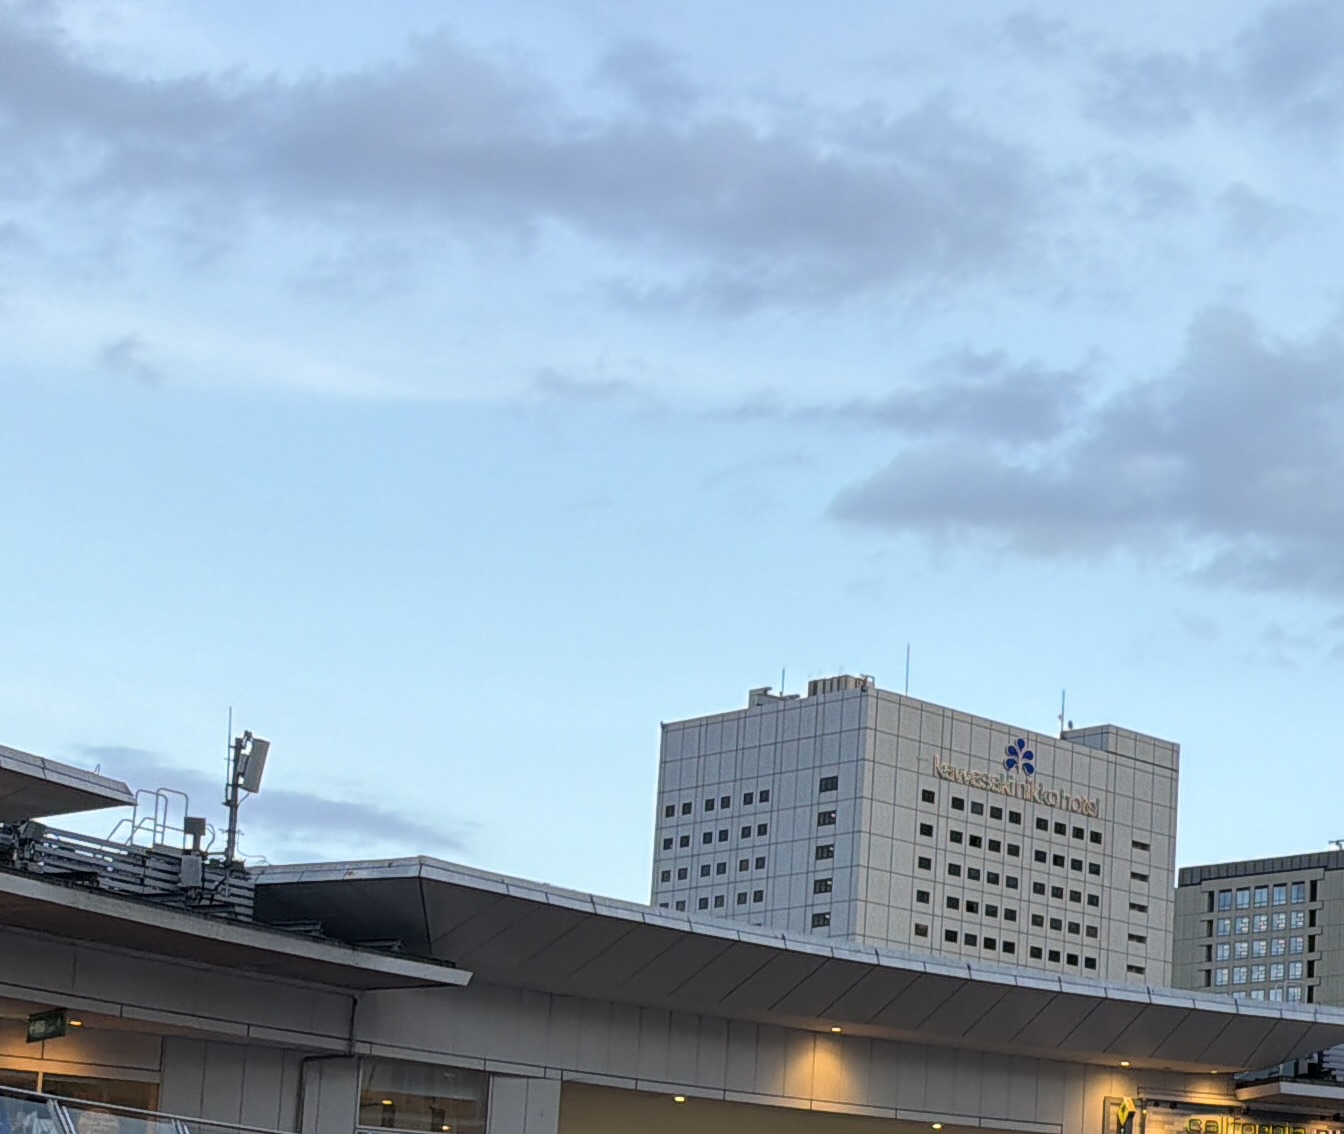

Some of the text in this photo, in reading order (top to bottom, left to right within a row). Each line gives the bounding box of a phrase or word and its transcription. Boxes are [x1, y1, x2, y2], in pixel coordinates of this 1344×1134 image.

[933, 754, 1100, 818] kawasaki nikko hotel
